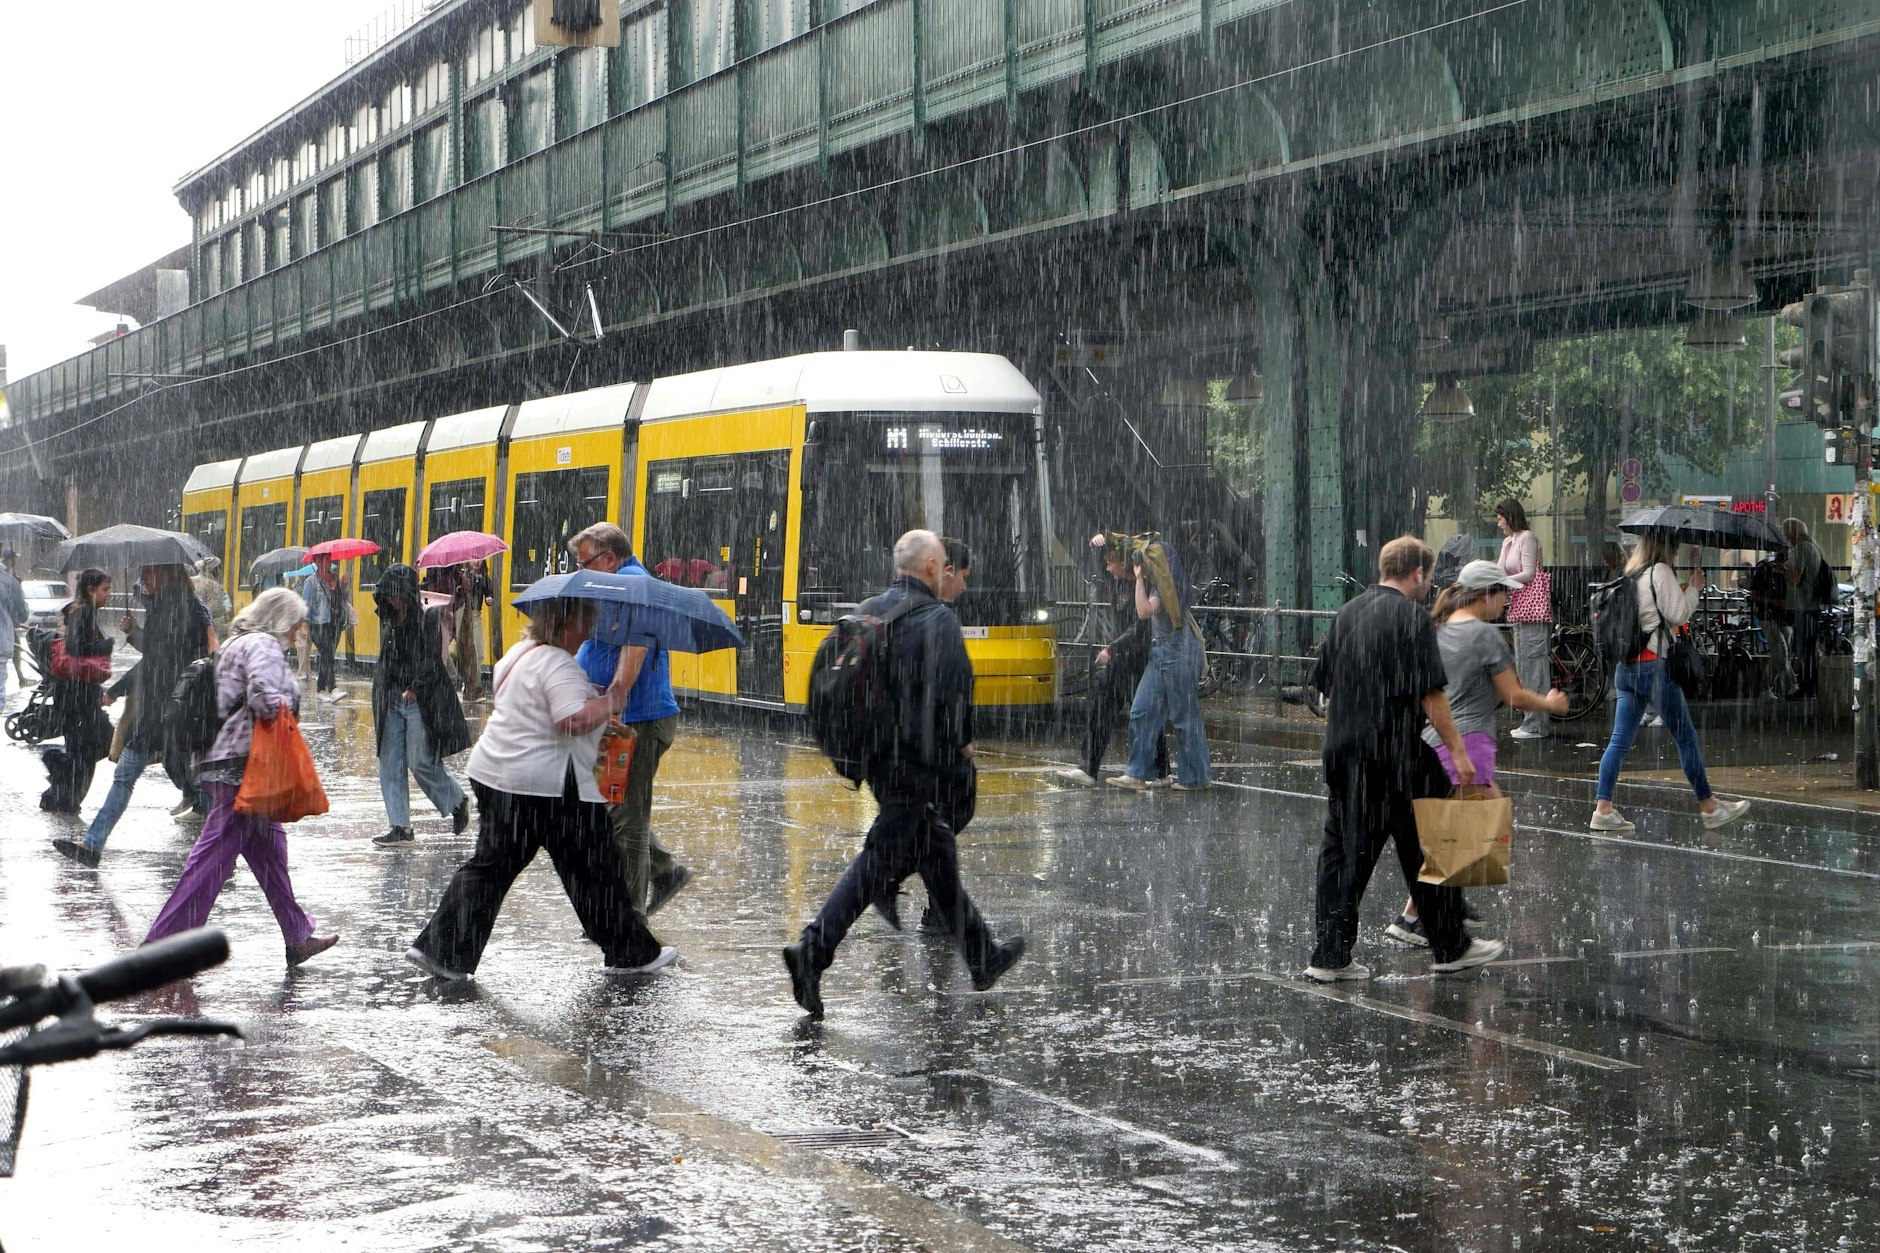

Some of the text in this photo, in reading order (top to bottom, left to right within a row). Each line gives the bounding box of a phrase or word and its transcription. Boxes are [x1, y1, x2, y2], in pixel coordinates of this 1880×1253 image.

[887, 428, 907, 448] M1
[932, 438, 990, 448] Schillerstr.
[1734, 500, 1765, 513] APOTHE
